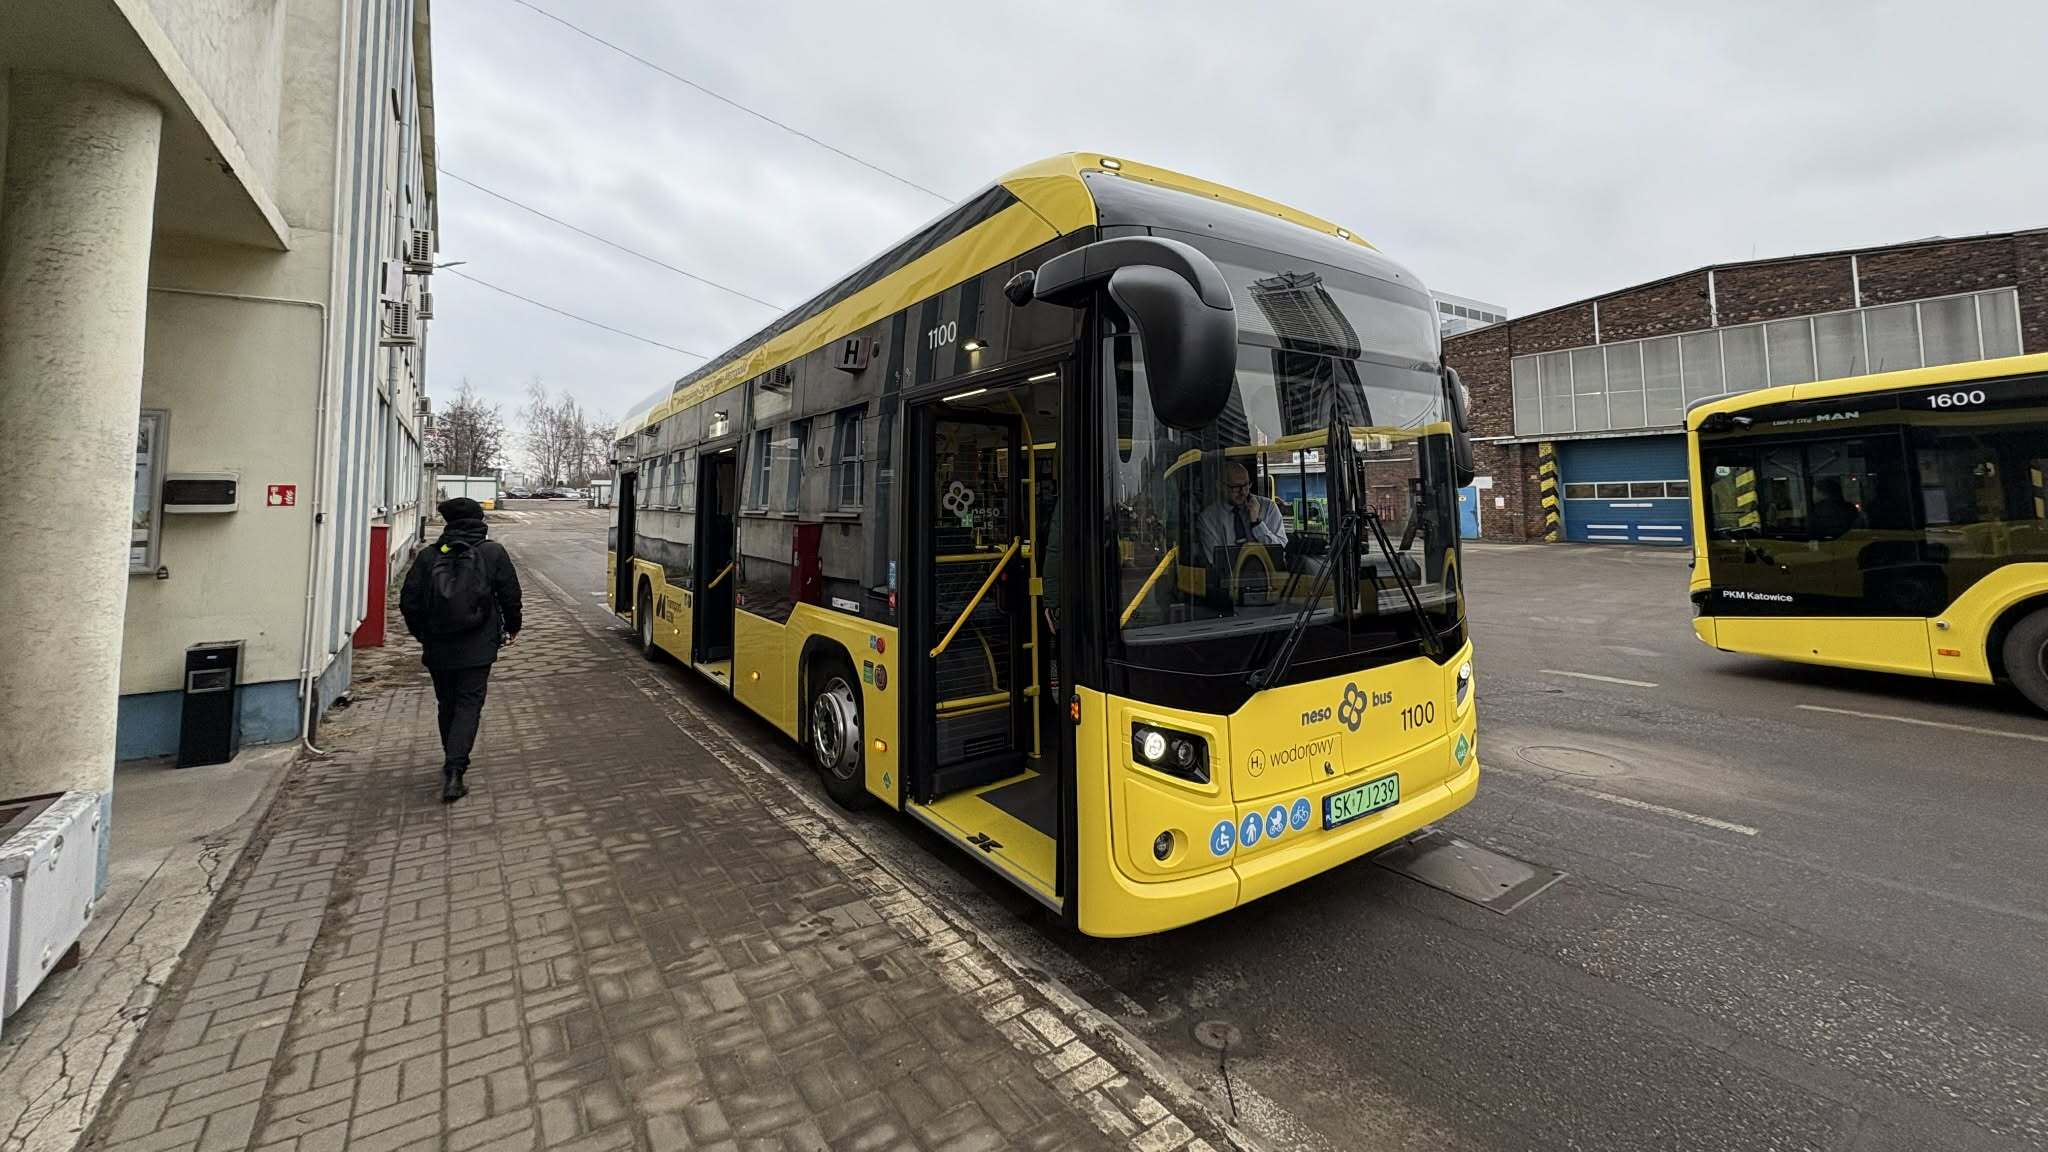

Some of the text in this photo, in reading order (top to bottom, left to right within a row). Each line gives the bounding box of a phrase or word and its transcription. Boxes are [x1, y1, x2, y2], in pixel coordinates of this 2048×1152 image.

[928, 321, 957, 350] 1100
[1926, 390, 1986, 409] 1600
[1816, 410, 1860, 422] MAN
[1722, 590, 1794, 602] PKM Katowice
[1301, 690, 1393, 726] neso bus
[1400, 700, 1435, 731] 1100
[1270, 737, 1334, 768] wodorowy
[1334, 779, 1395, 819] SK 7J239
